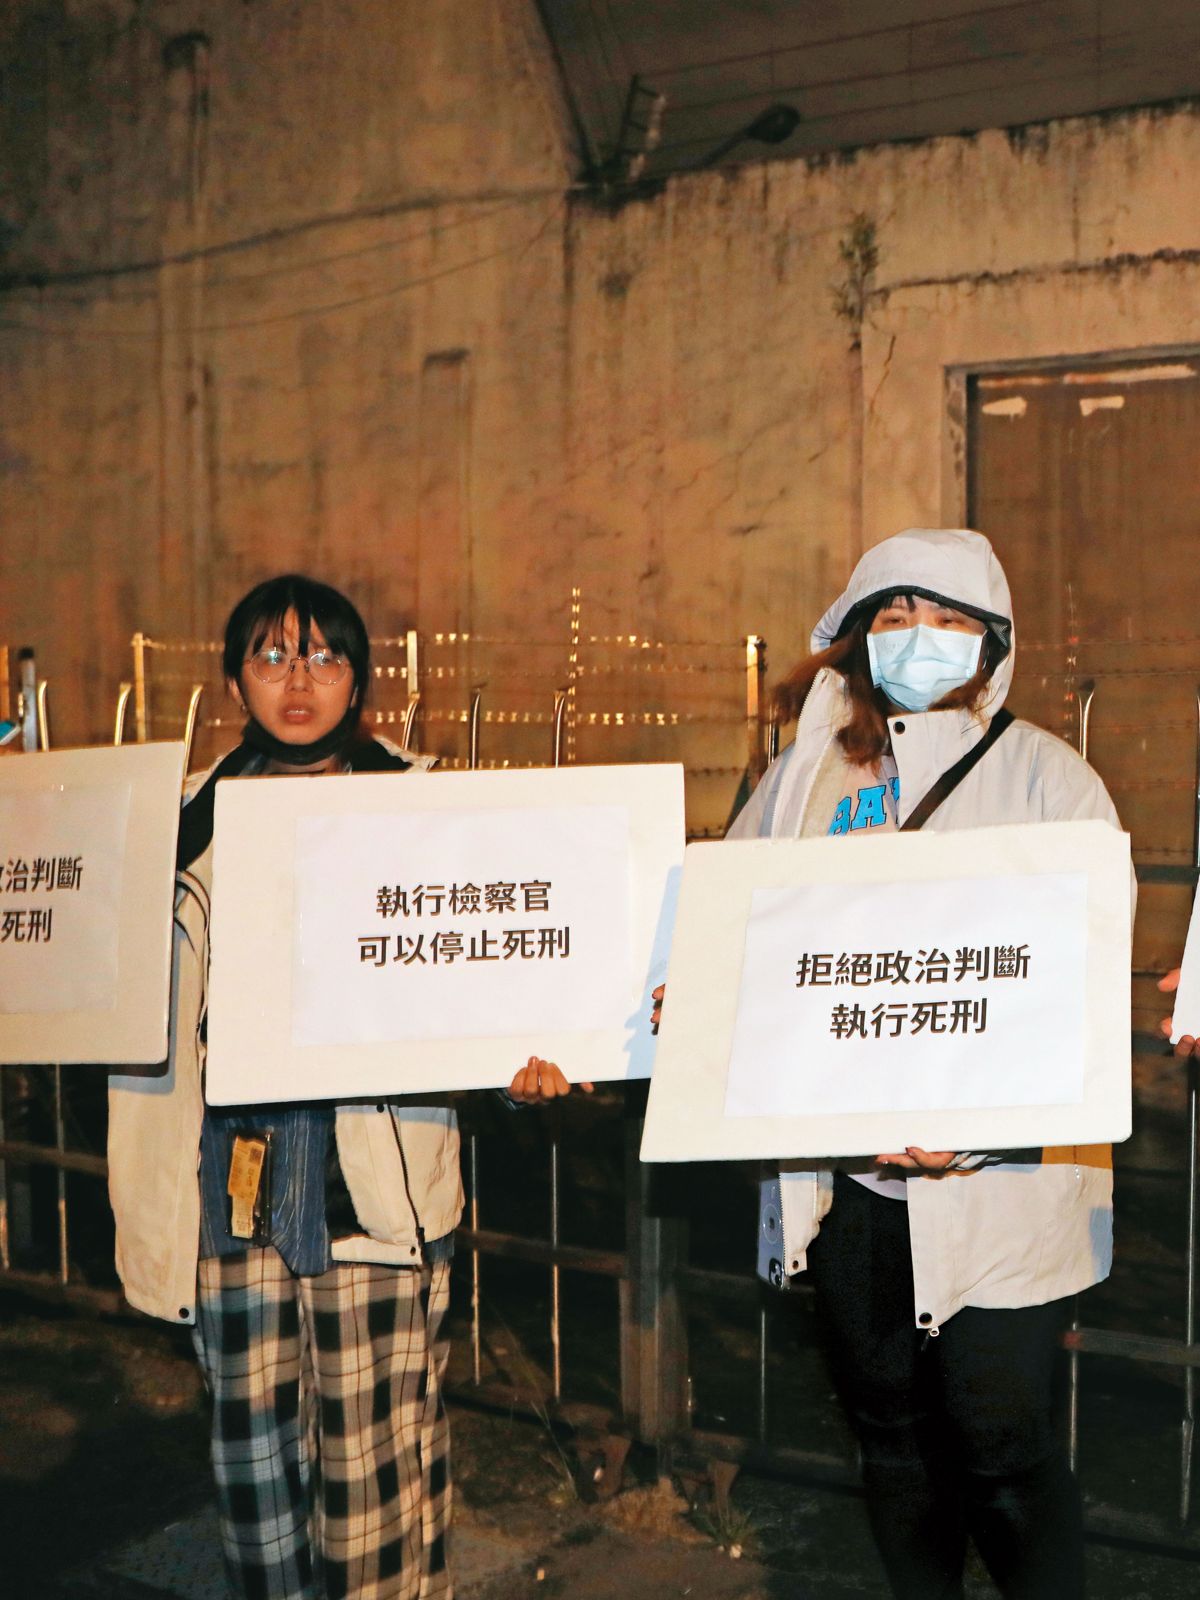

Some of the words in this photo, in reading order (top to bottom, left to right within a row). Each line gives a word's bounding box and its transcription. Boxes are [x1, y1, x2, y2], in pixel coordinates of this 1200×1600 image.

[375, 879, 553, 920] 執行檢察官
[358, 926, 570, 968] 可以停止死刑
[795, 943, 1032, 989] 拒絕政治判斷
[830, 997, 988, 1040] 執行死刑
